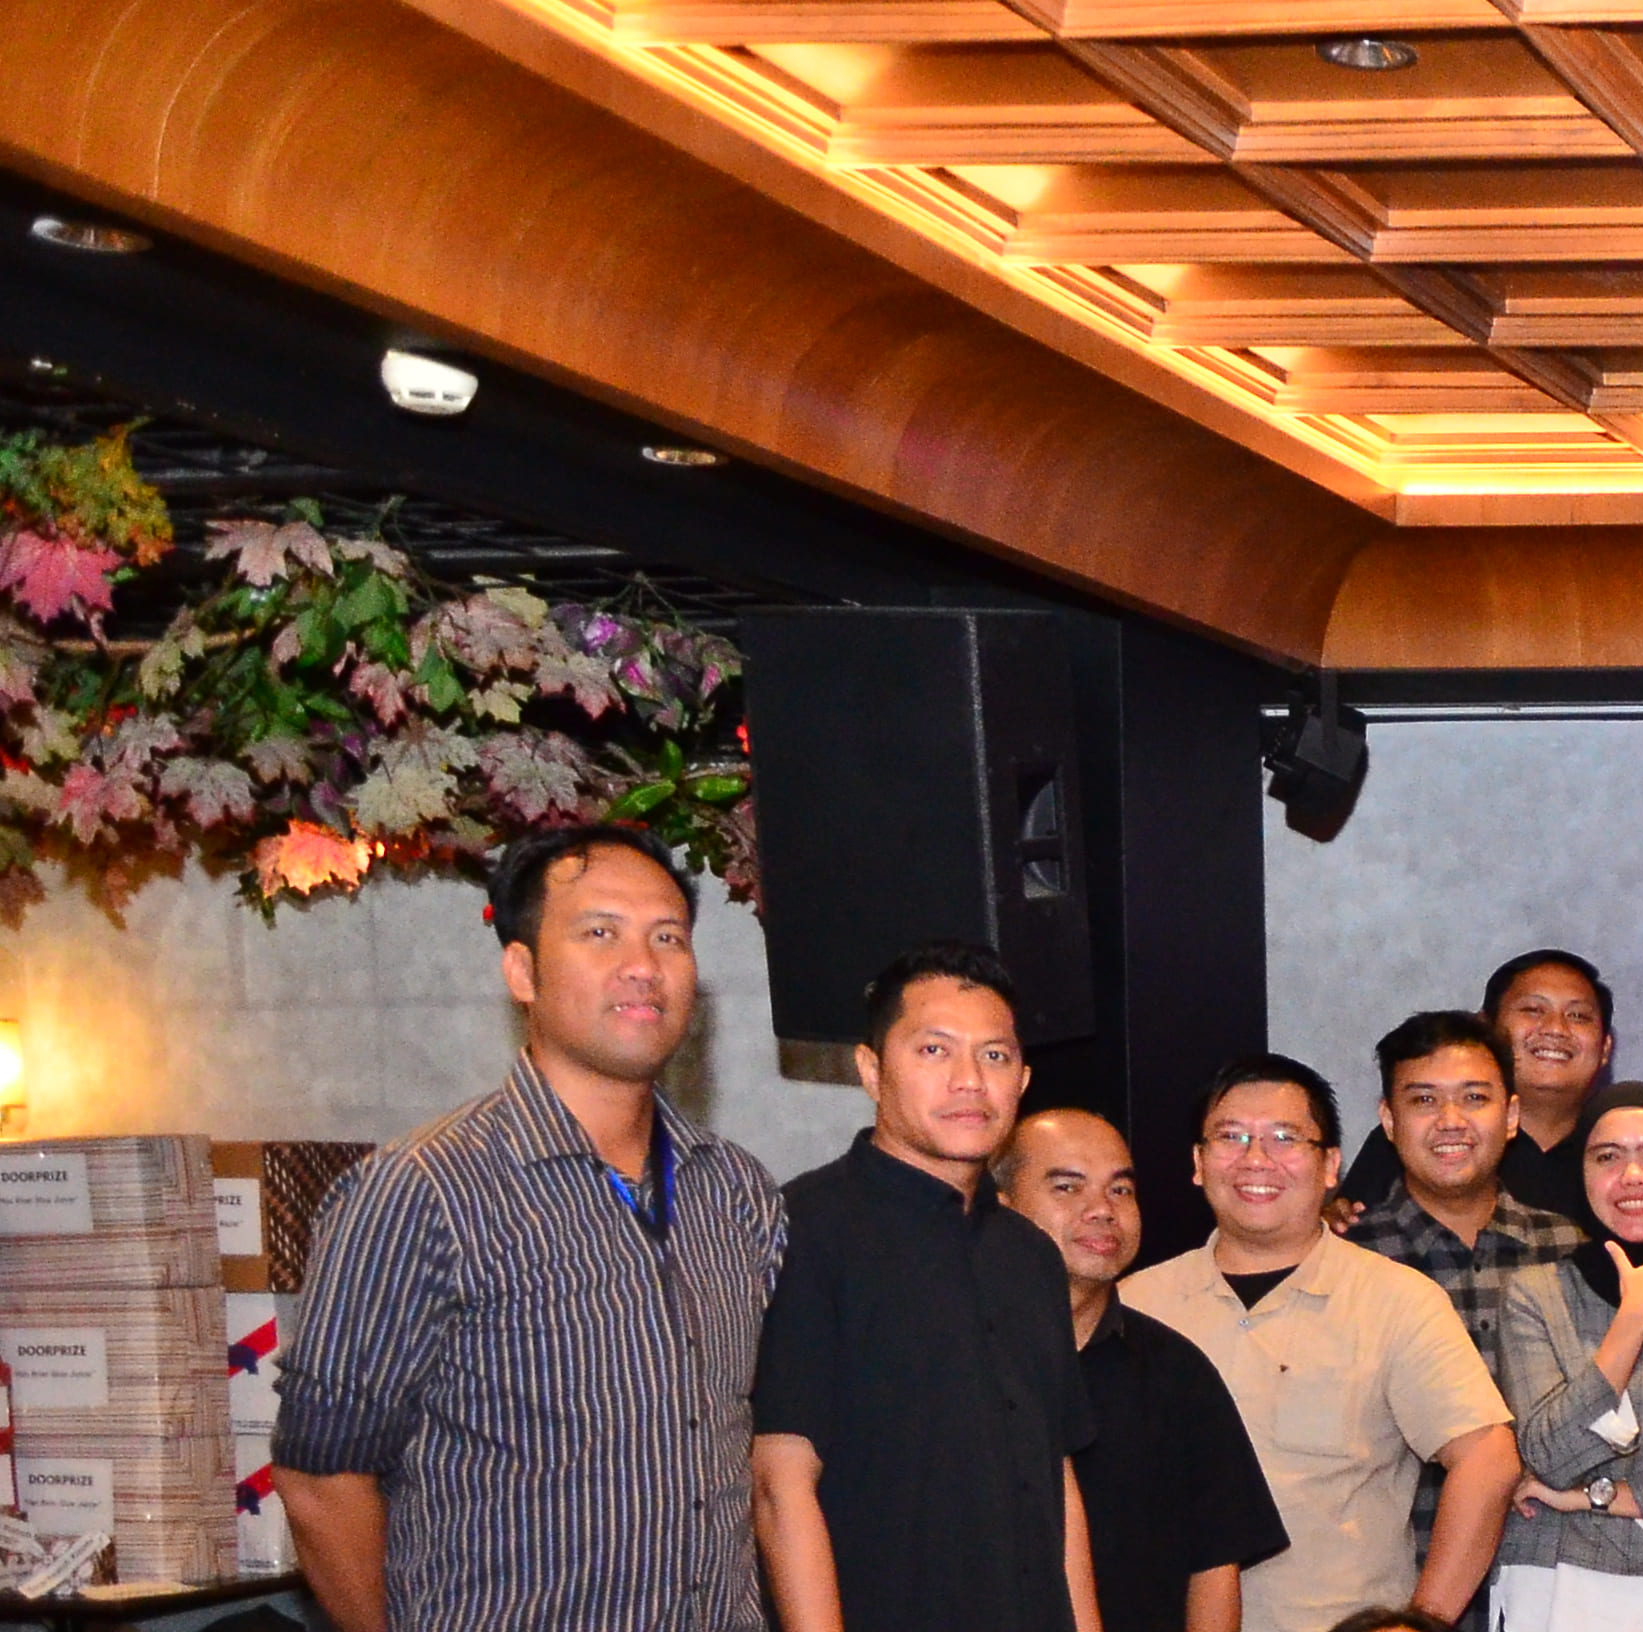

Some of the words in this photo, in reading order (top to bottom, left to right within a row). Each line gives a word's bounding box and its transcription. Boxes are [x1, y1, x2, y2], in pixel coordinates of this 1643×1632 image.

[1, 1171, 68, 1182] DOORPRIZE
[18, 1345, 87, 1356] DOORPRIZE
[29, 1474, 93, 1486] DOORPRIZE
